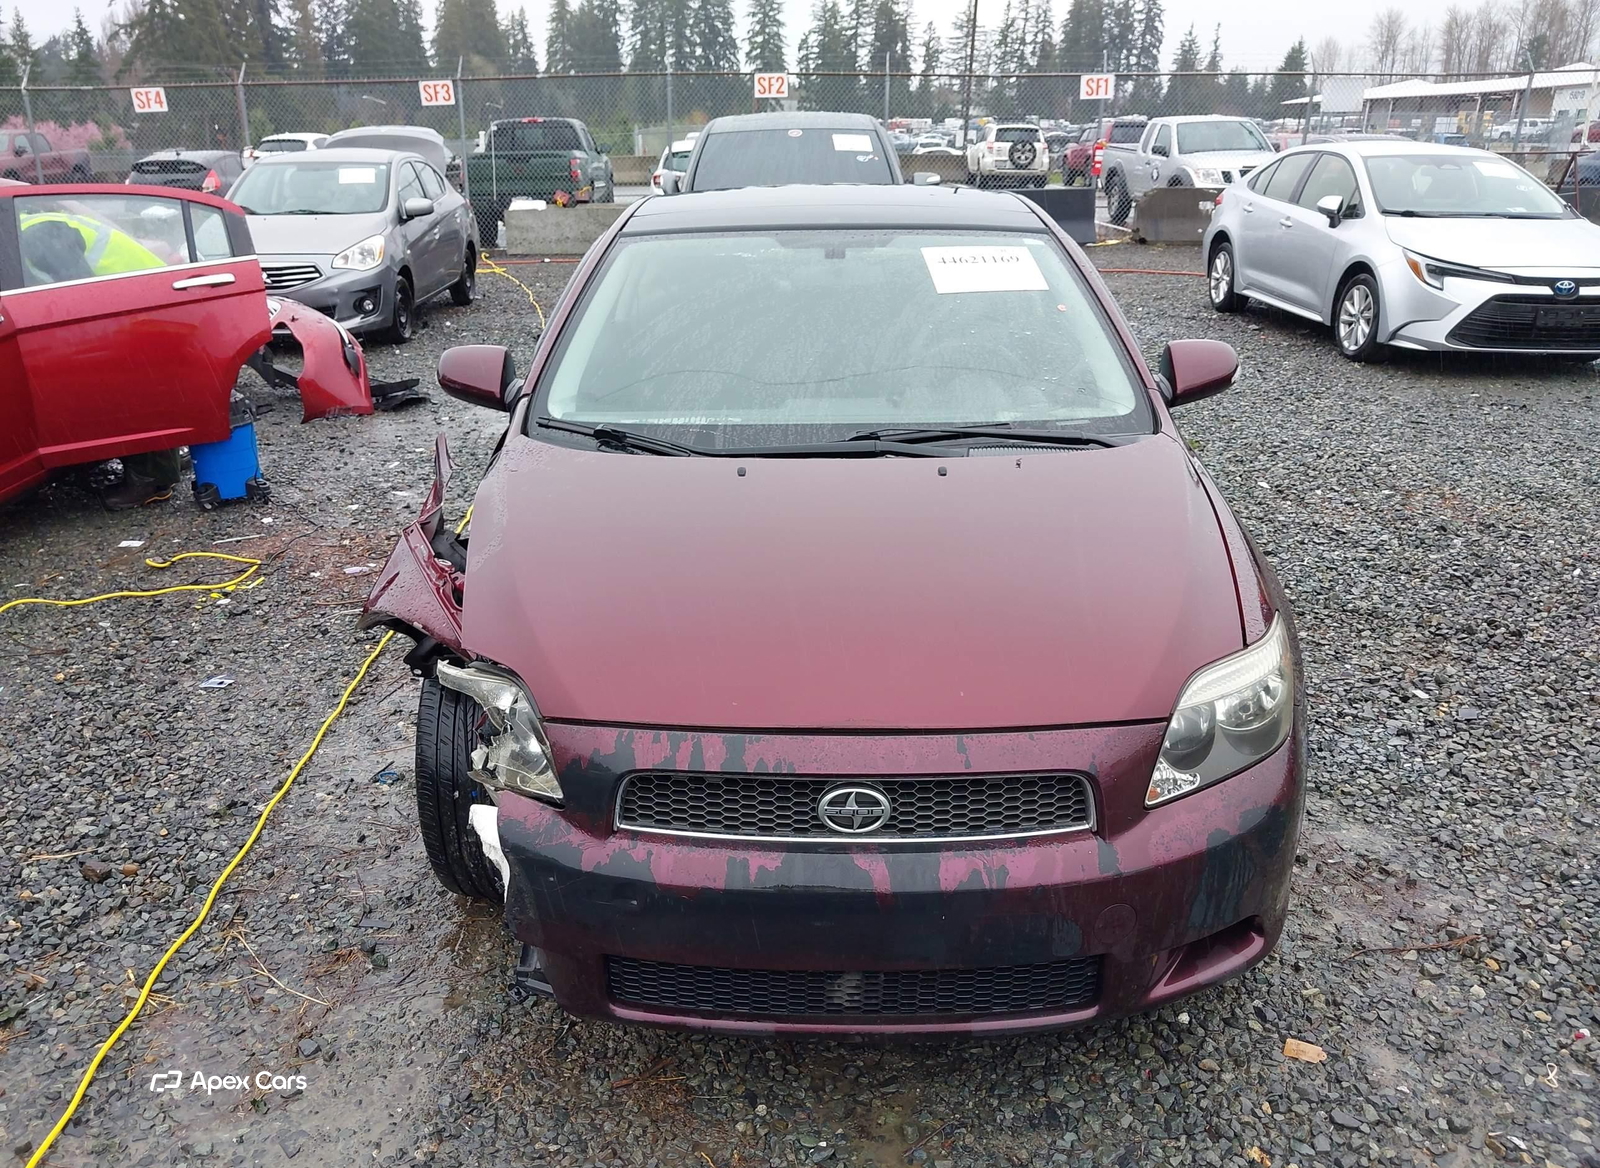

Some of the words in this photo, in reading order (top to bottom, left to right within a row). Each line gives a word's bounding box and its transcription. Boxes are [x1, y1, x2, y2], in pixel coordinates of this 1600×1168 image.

[423, 84, 451, 102] SF3
[757, 76, 785, 95] SF2
[1085, 77, 1109, 96] SF1
[135, 91, 164, 109] SF4
